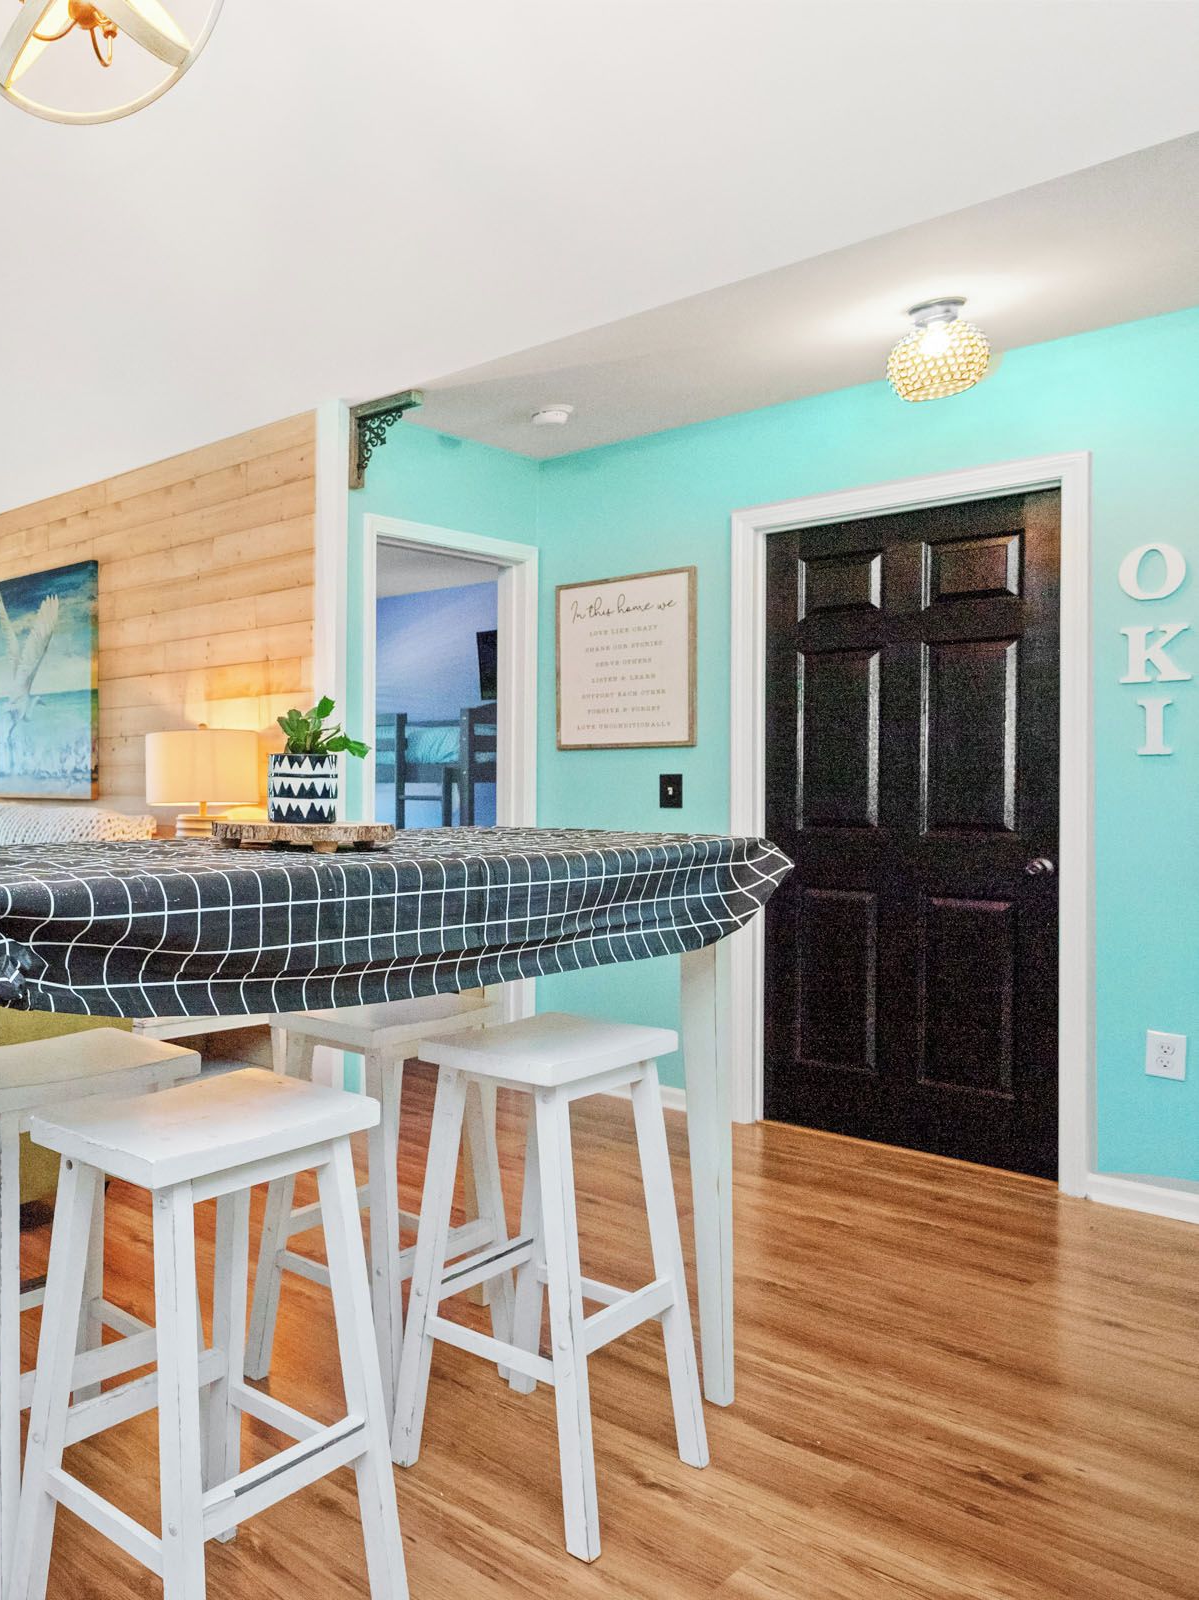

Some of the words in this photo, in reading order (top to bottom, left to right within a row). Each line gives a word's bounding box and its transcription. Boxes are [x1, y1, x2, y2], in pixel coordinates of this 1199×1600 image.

[570, 600, 586, 624] In
[587, 596, 615, 618] this
[617, 593, 654, 614] home
[657, 599, 678, 611] we
